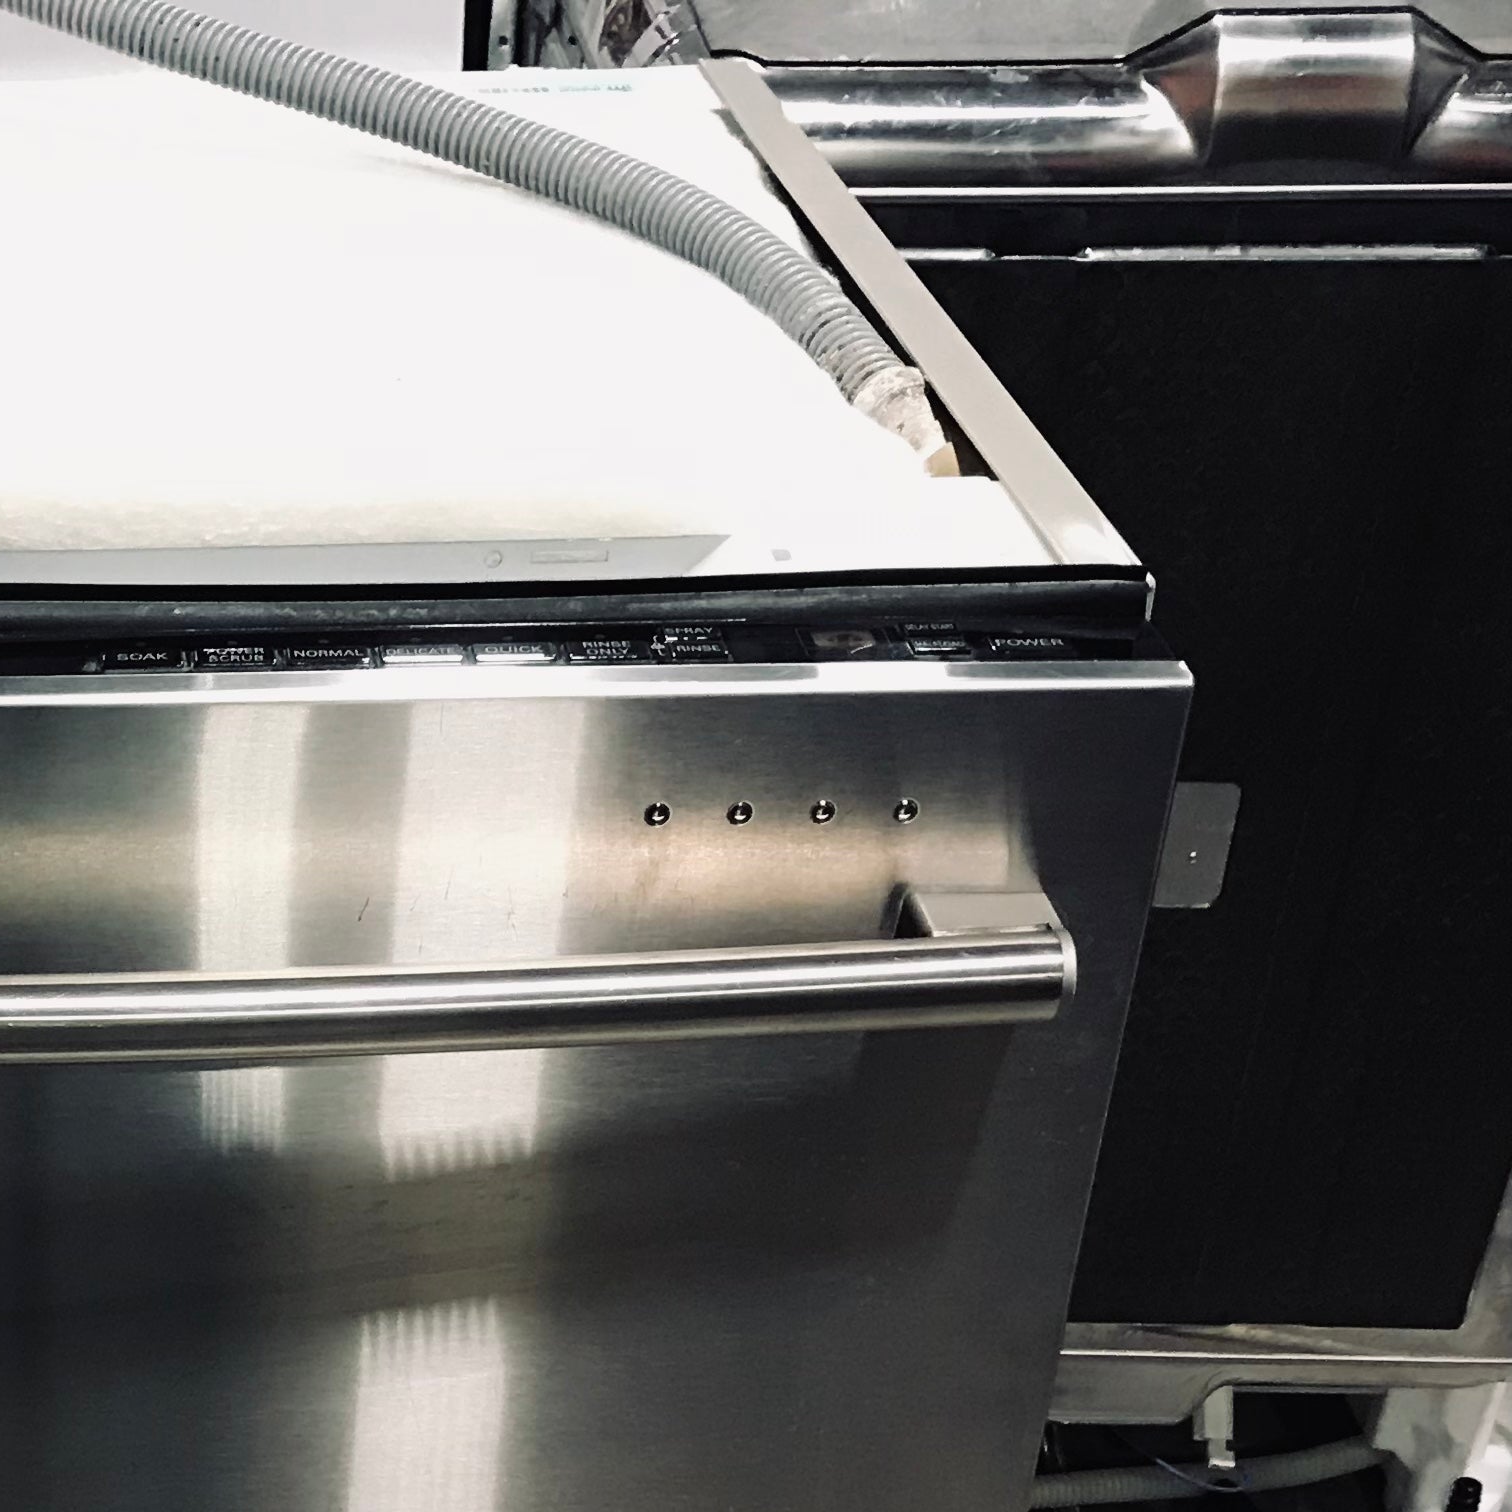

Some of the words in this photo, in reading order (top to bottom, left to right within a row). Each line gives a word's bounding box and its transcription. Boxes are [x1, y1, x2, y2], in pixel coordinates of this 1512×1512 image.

[582, 641, 630, 649] RINSE
[994, 638, 1064, 647] POWER
[386, 647, 456, 656] DELICATE
[485, 645, 543, 654] QUICK
[587, 648, 629, 656] ONLY
[676, 644, 721, 652] RINSE
[117, 652, 168, 661] SOAK
[208, 654, 264, 662] SCRUB
[293, 649, 364, 658] NORMAL
